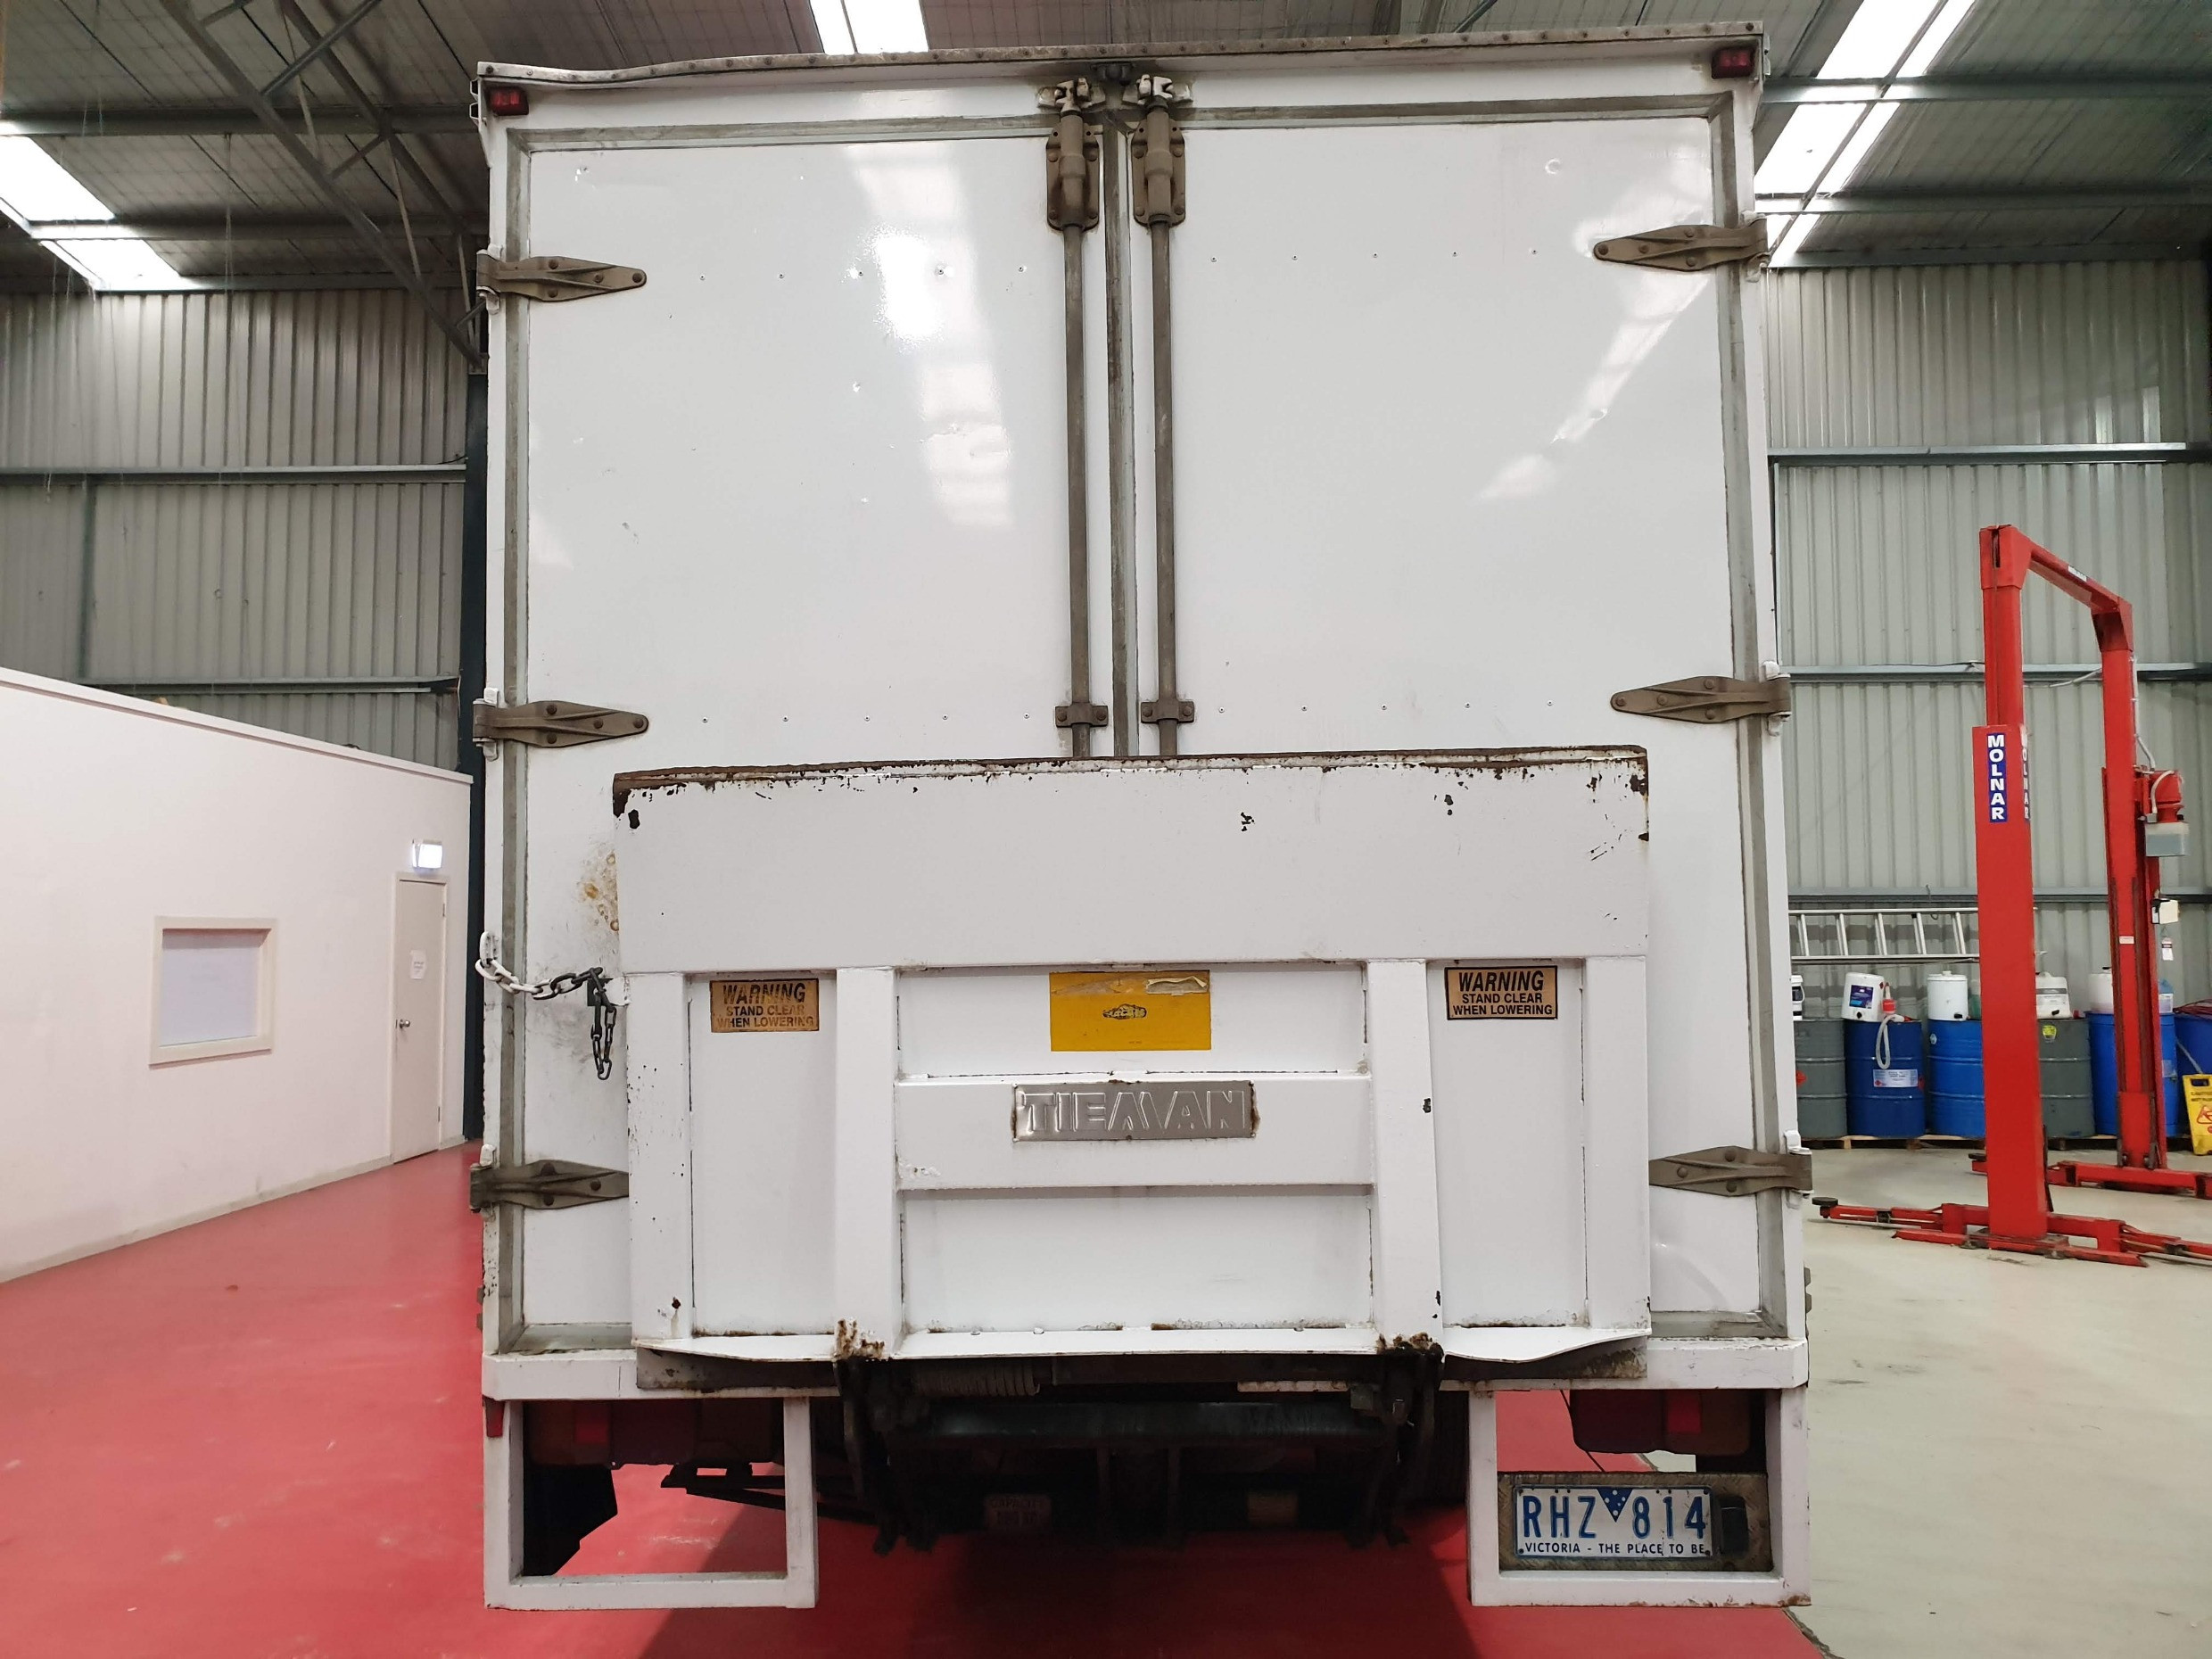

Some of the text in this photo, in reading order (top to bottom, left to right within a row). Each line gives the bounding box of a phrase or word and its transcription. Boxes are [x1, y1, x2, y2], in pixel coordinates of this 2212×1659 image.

[1987, 734, 2005, 820] MOLNAR
[1458, 970, 1545, 992] WARNING
[722, 982, 806, 1004] WARNING
[1462, 993, 1543, 1003] STAND CLEAR
[726, 1005, 805, 1017] STAND CLEAR
[1452, 1004, 1553, 1015] WHEN LOWERING
[716, 1016, 814, 1028] WHEN LOWERING
[1017, 1090, 1246, 1134] TIEMAN
[1522, 1495, 1706, 1539] RHZ 814
[1524, 1543, 1581, 1554] VICTORIA
[1598, 1543, 1621, 1554] THE
[1627, 1543, 1663, 1554] PLACE
[1669, 1543, 1685, 1554] TO
[1691, 1543, 1705, 1554] BE
